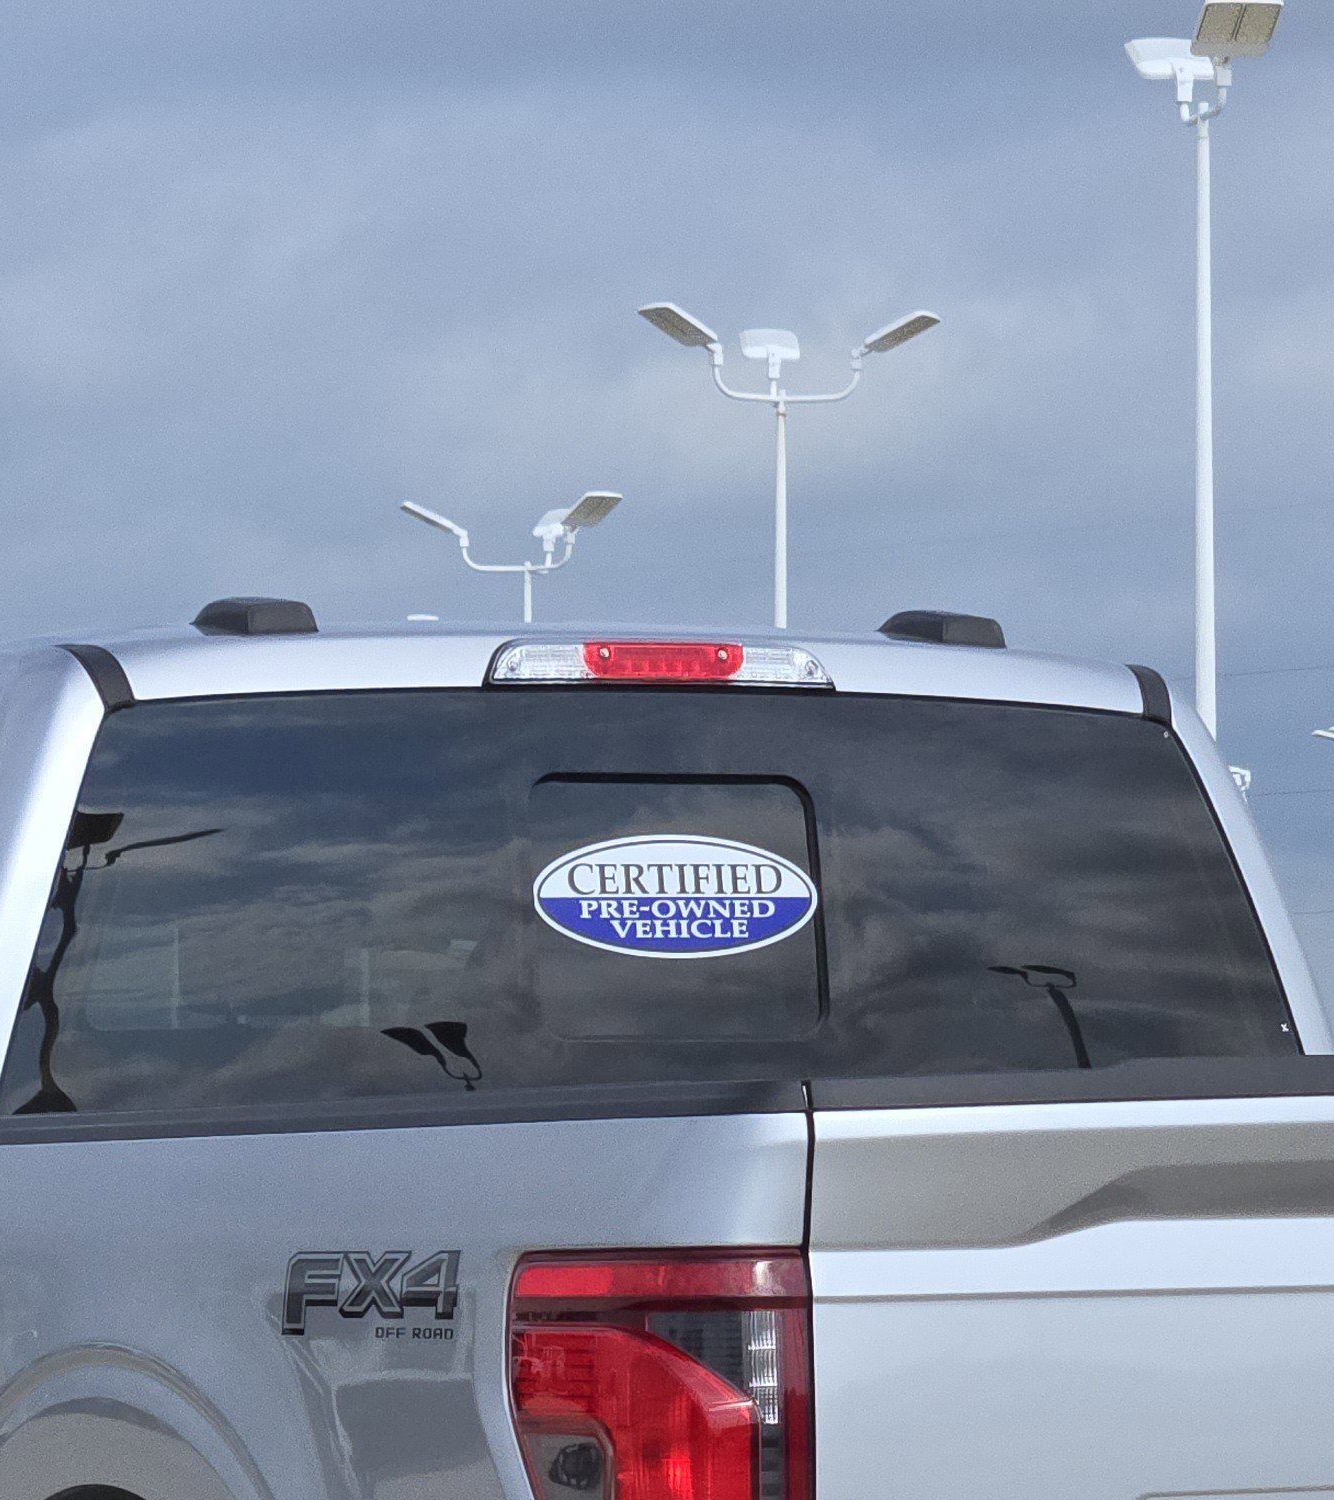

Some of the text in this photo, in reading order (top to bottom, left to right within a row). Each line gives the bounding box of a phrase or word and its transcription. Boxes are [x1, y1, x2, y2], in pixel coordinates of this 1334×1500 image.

[567, 863, 783, 895] CERTIFIED
[579, 900, 775, 919] PRE-OWNED
[610, 919, 749, 938] VEHICLE
[281, 1250, 461, 1336] FX4
[375, 1327, 454, 1340] OFF ROAD
